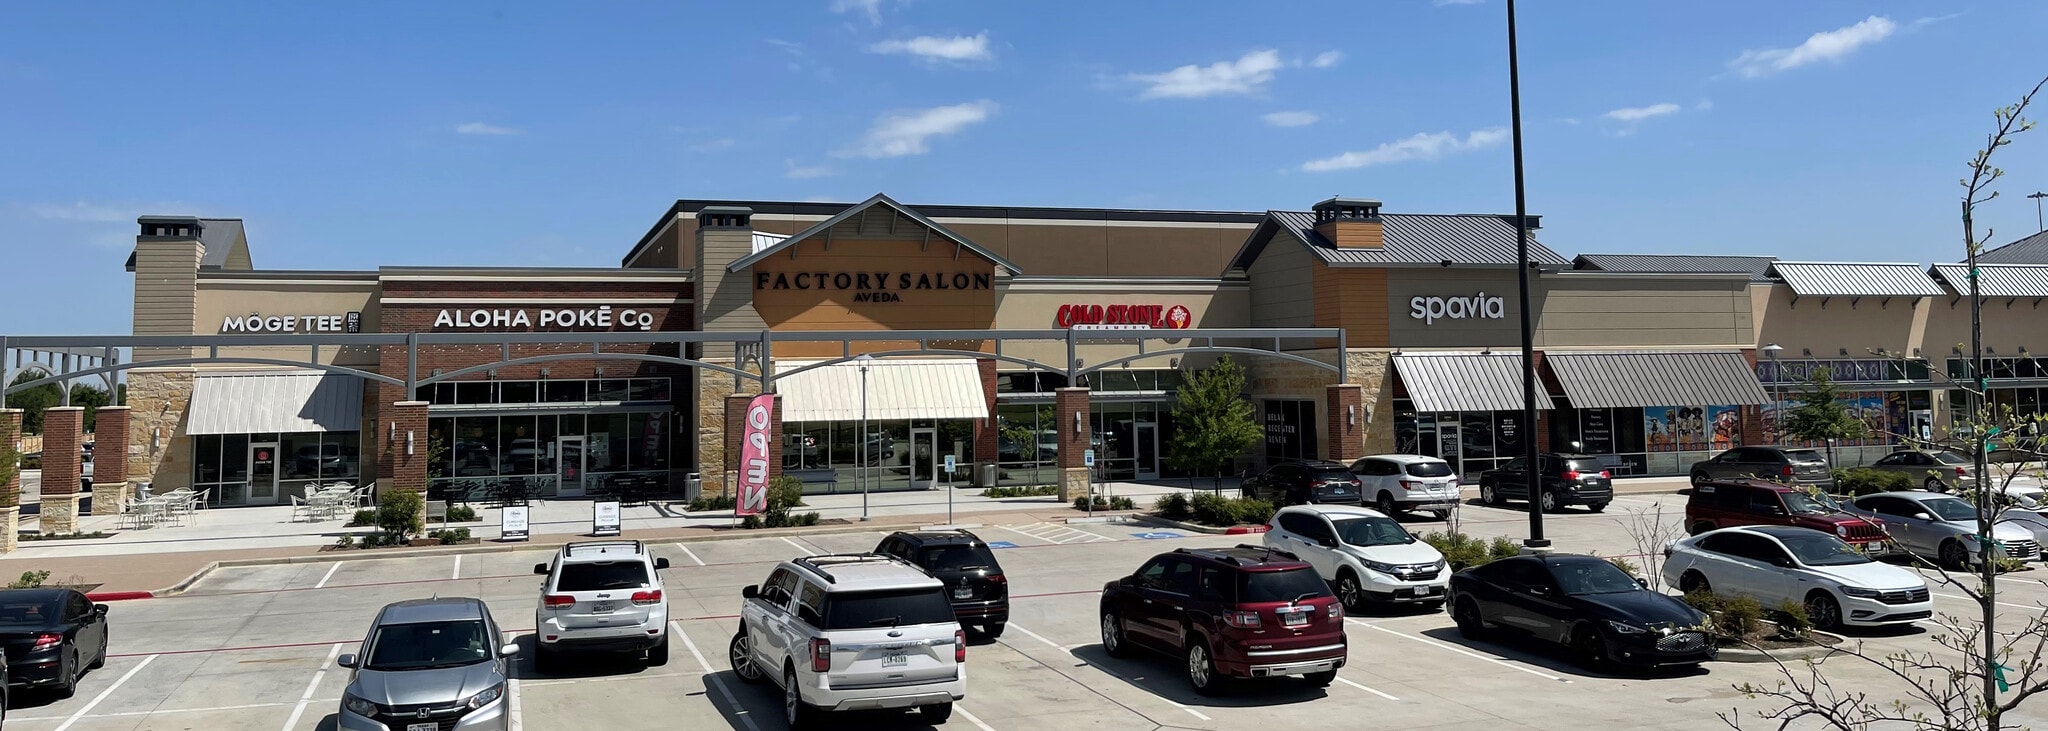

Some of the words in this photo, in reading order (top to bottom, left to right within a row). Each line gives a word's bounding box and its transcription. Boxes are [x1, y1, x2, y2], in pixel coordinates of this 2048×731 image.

[756, 272, 890, 290] FACTORY
[900, 272, 991, 290] SALON
[1057, 304, 1104, 328] COLD
[1106, 304, 1164, 328] STONE
[1410, 291, 1505, 325] spavia
[222, 312, 295, 332] MÖGE
[300, 315, 342, 332] TEE
[433, 309, 531, 328] ALOHA
[619, 309, 654, 331] Co
